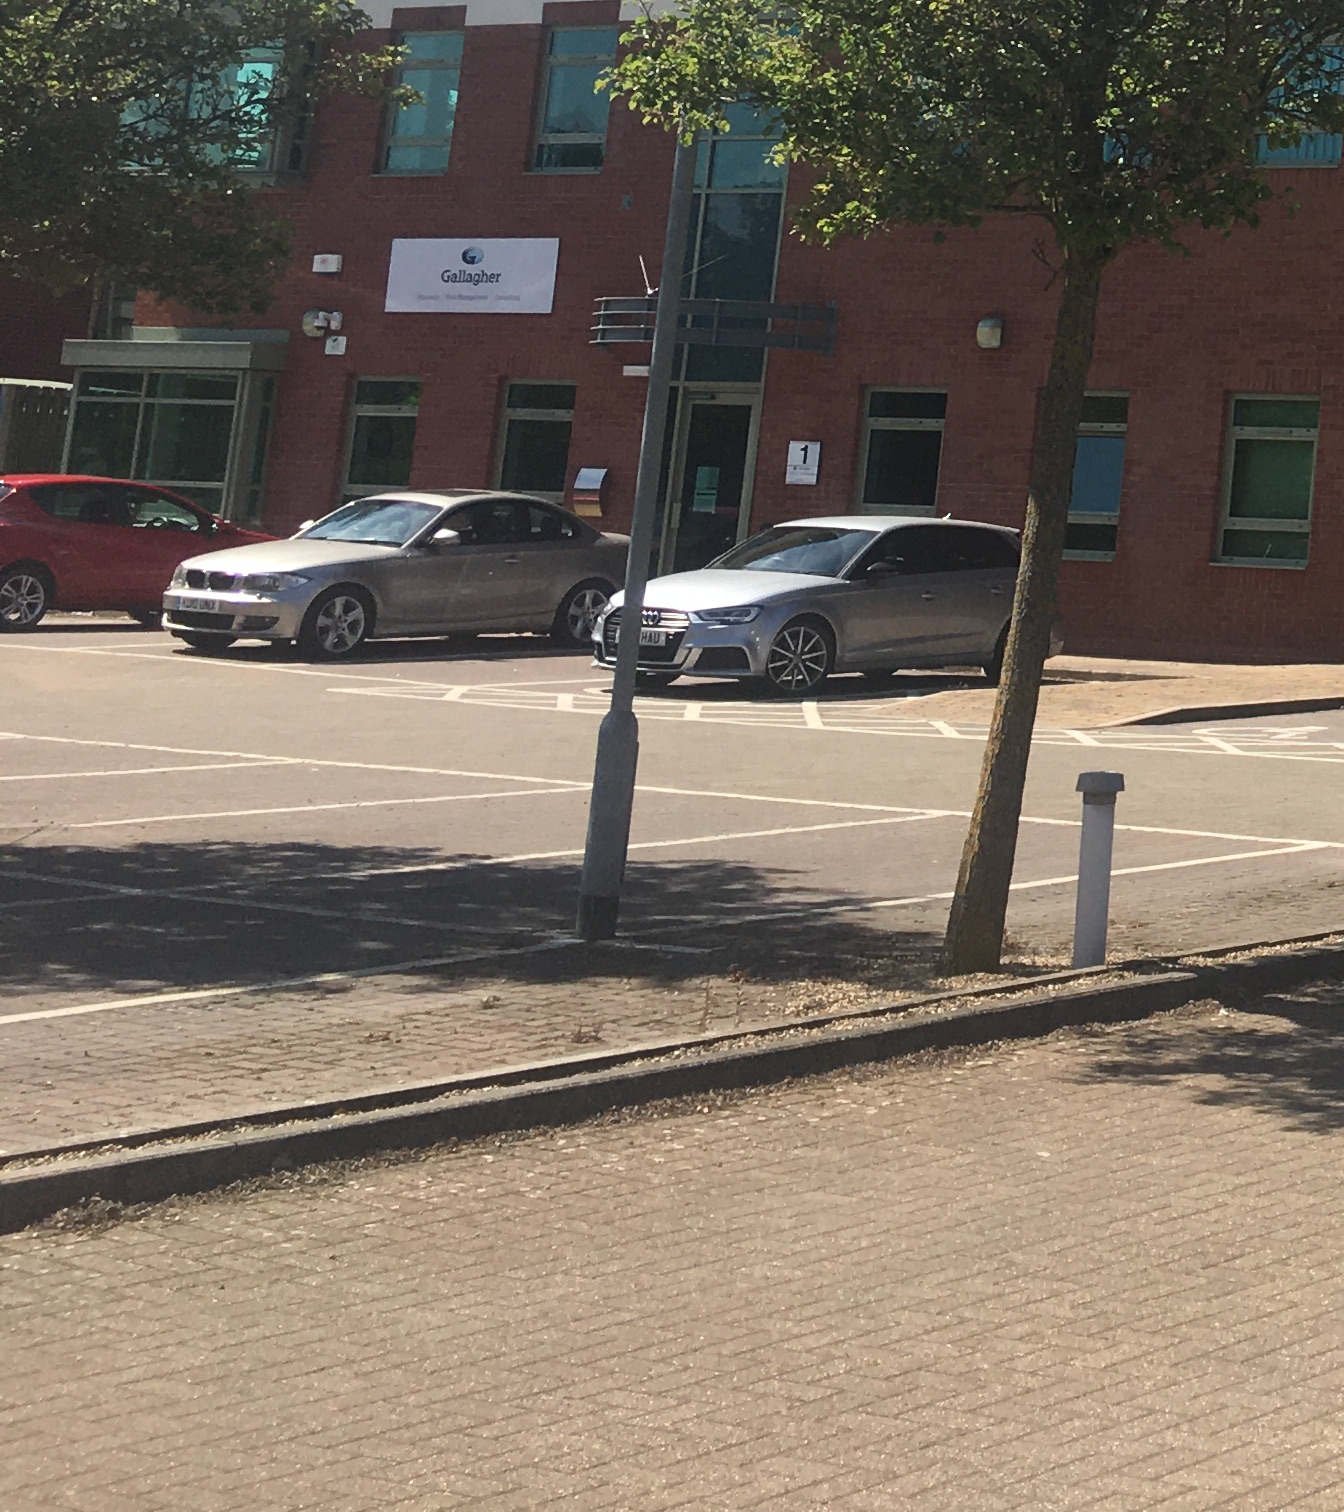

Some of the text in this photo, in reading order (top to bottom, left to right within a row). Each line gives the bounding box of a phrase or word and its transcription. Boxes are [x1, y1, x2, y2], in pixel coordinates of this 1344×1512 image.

[441, 269, 501, 286] Gallagher
[800, 444, 809, 465] 1
[641, 631, 660, 644] HAU
